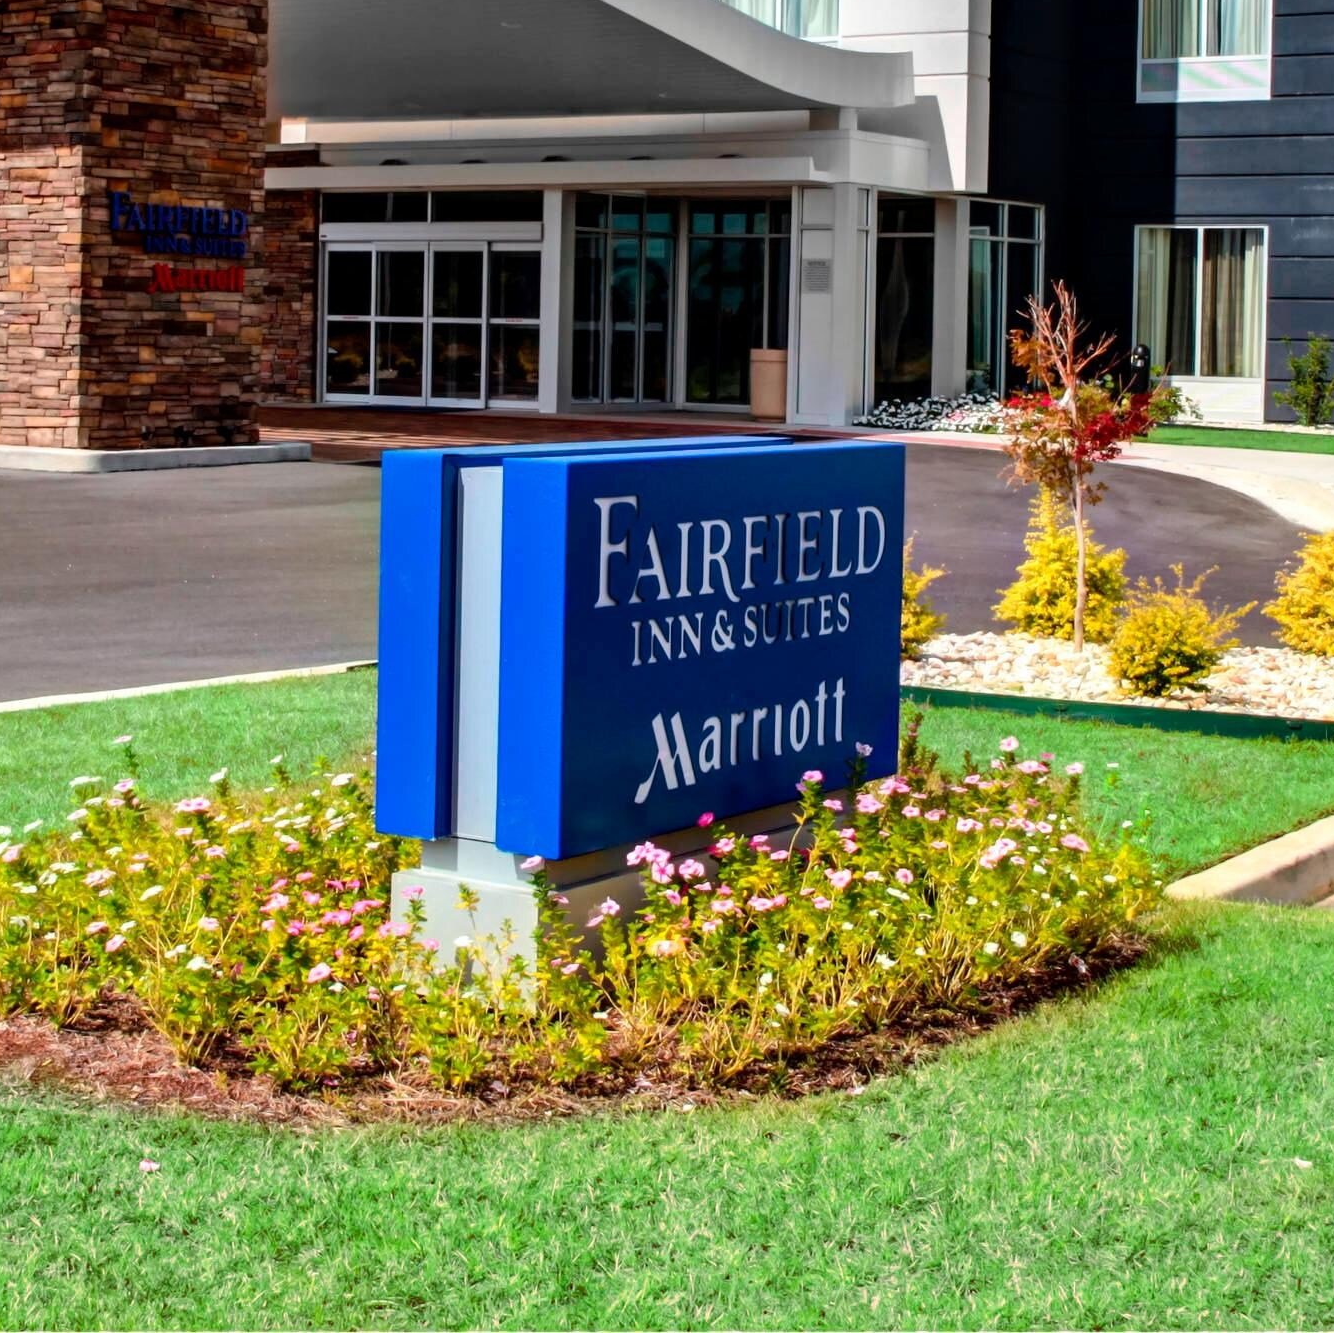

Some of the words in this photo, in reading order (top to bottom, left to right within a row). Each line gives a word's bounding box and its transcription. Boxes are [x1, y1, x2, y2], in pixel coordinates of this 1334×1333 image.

[108, 191, 248, 236] FAIRFIELD
[145, 262, 245, 294] Marriott
[593, 494, 886, 608] FAIRFIELD
[631, 612, 705, 667] INN
[742, 591, 851, 648] SUITES
[634, 676, 846, 804] Marriott
